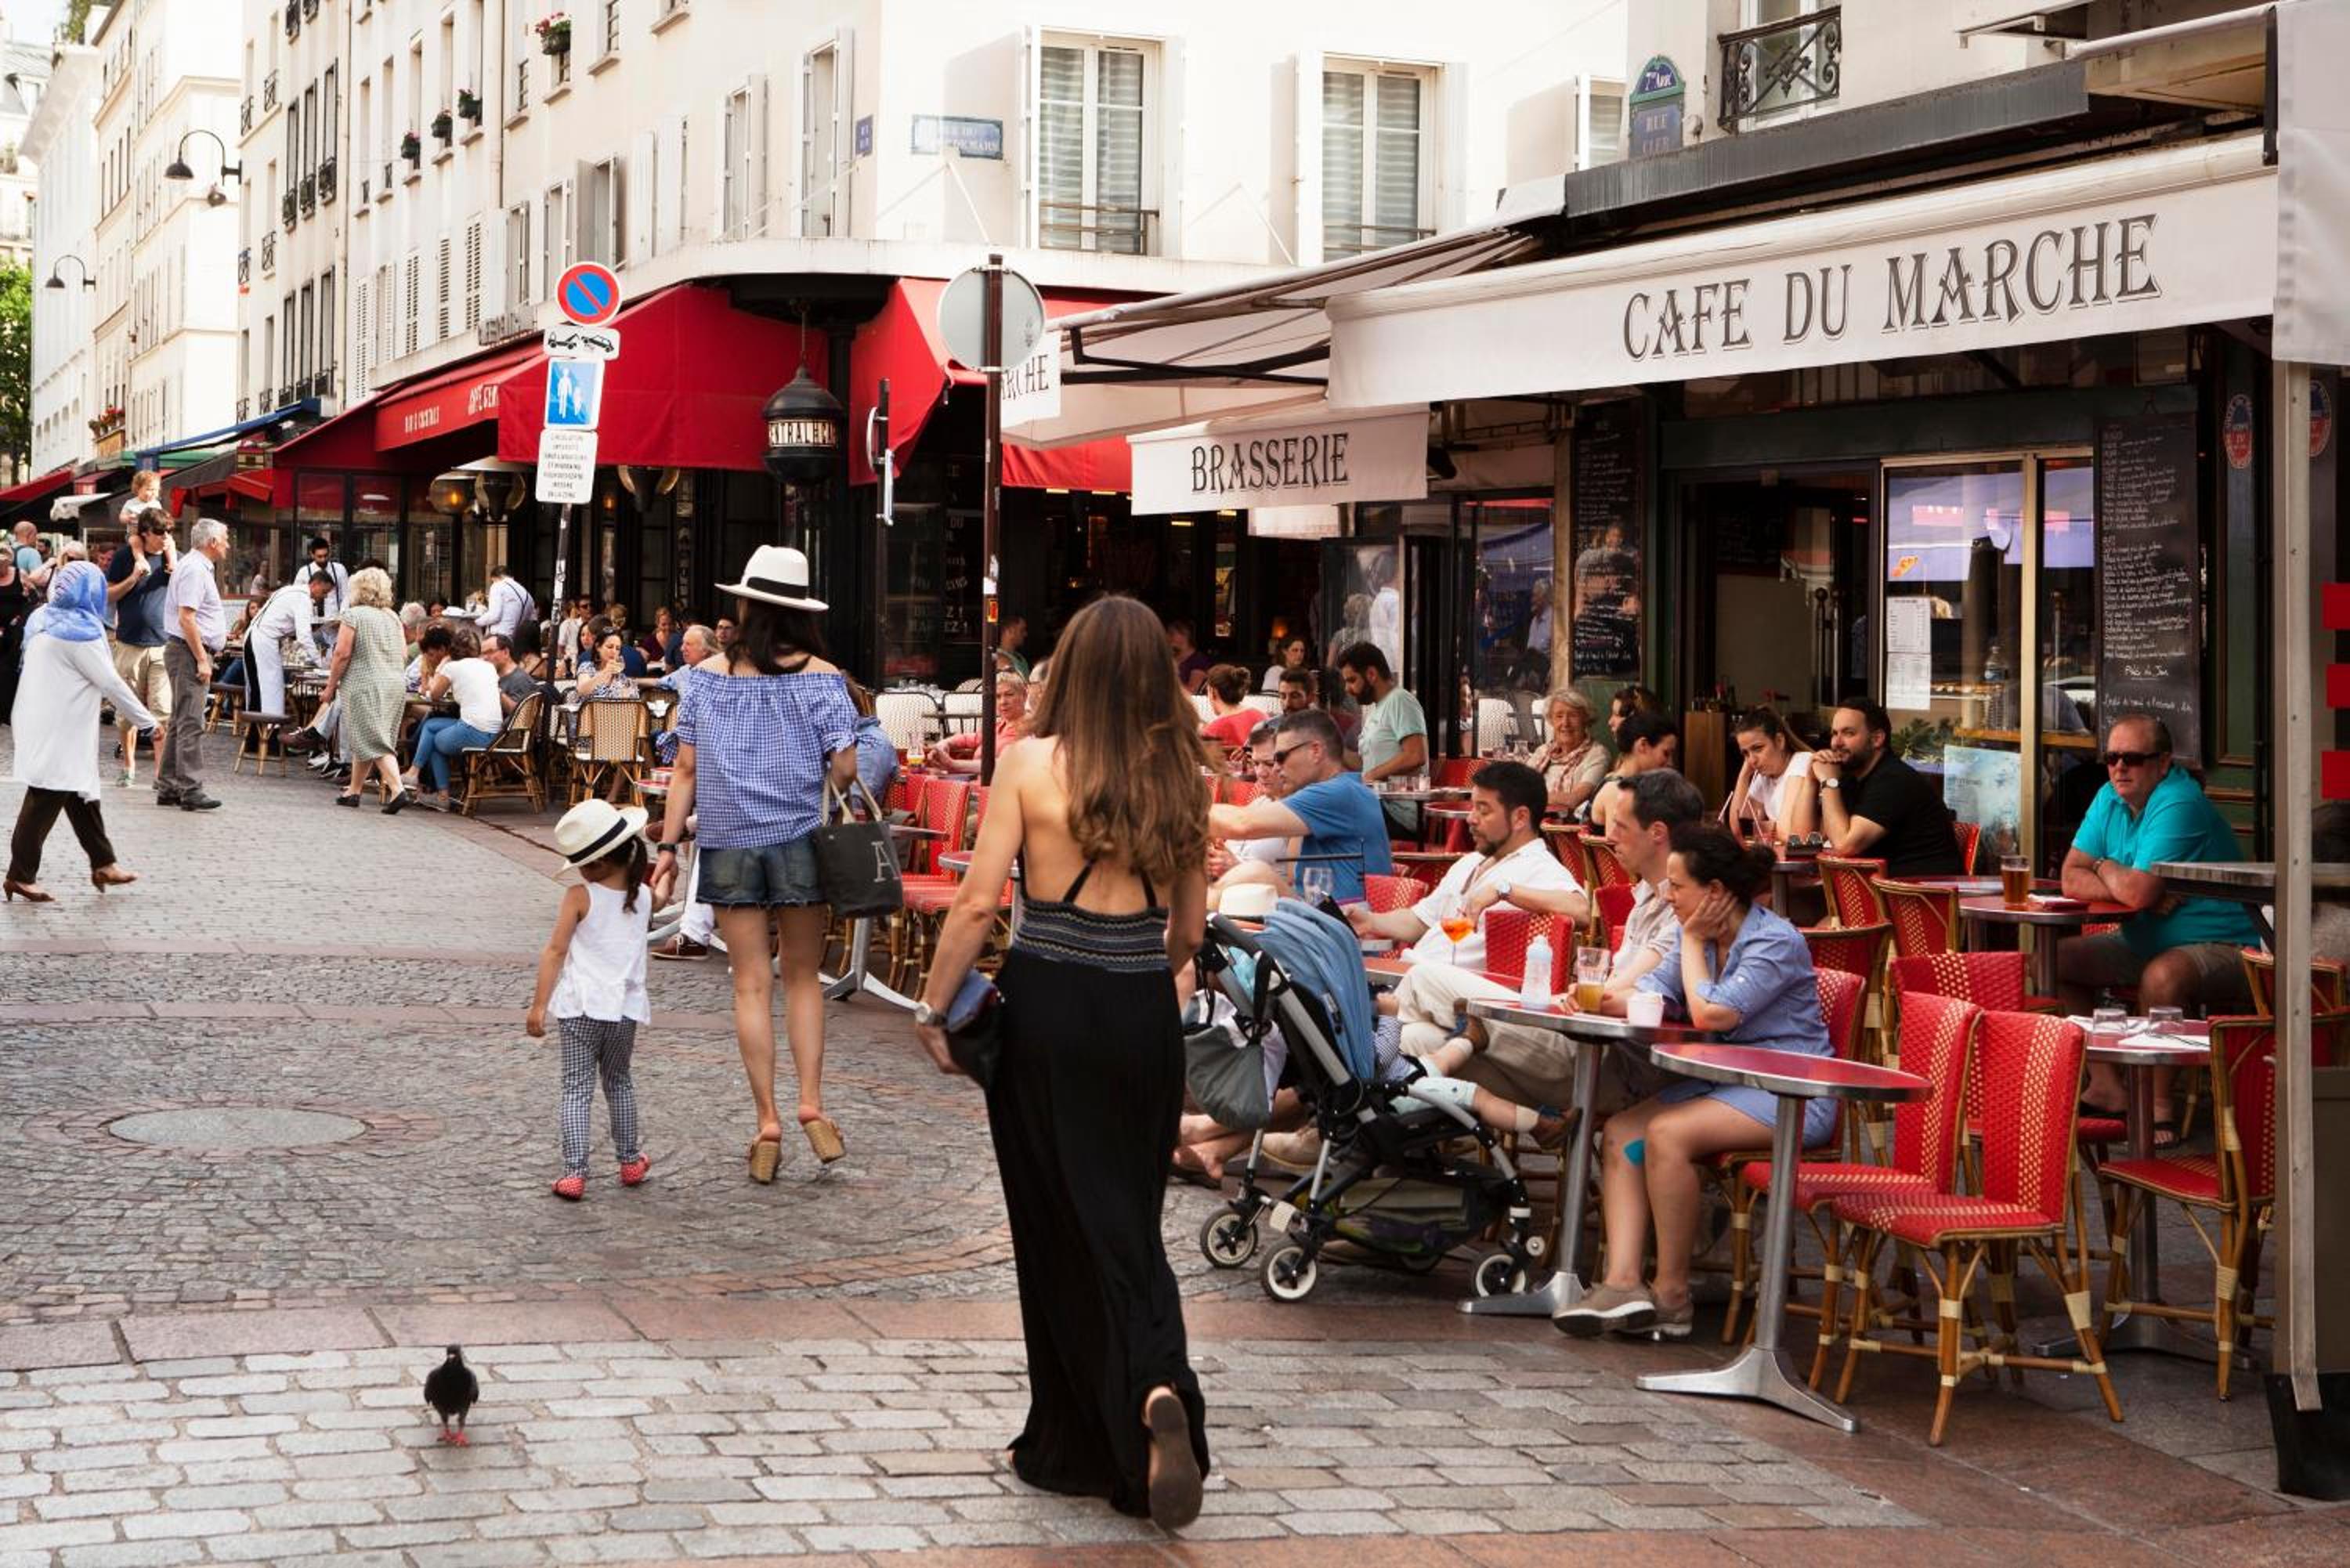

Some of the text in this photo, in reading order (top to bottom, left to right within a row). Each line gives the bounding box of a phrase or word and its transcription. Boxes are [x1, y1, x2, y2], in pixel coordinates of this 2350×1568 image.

[1623, 214, 2162, 362] CAFE DU MARCHE
[1191, 432, 1350, 494] BRASSERIE
[871, 841, 899, 883] A
